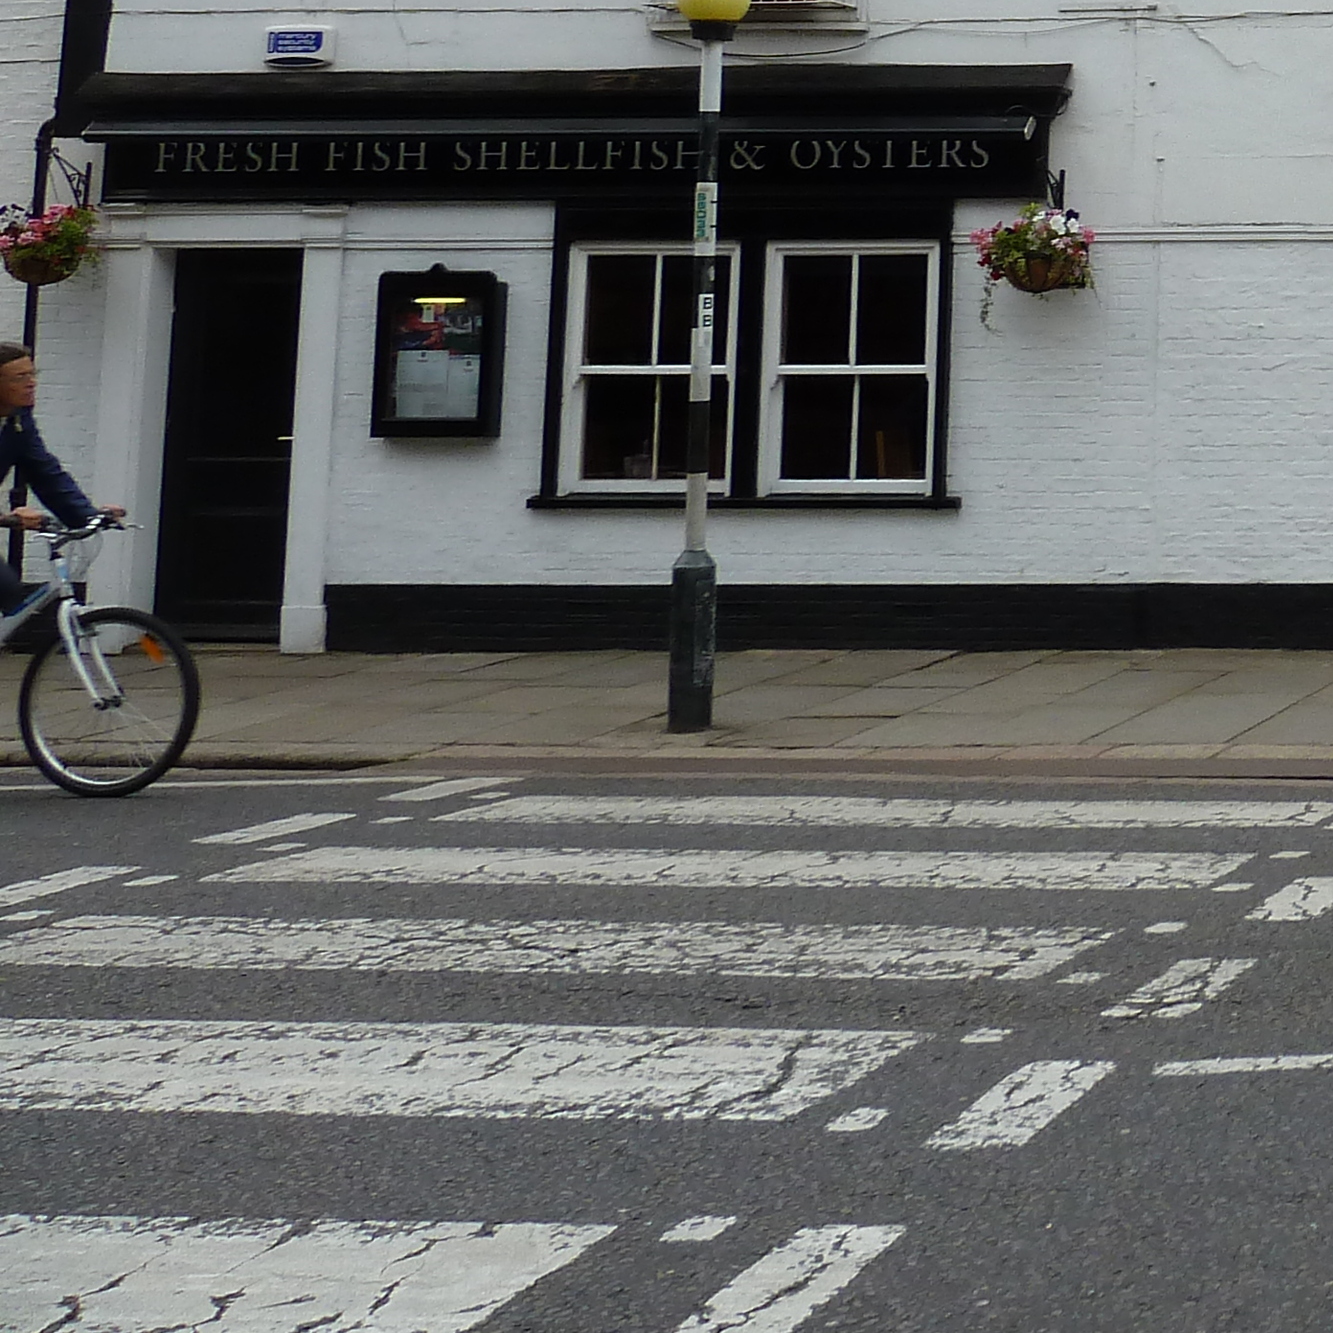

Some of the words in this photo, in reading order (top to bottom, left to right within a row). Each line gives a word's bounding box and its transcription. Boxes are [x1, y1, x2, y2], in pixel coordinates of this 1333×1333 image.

[154, 141, 300, 172] FRESH
[325, 140, 428, 171] FISH
[729, 139, 767, 170] &
[789, 139, 991, 169] OYSTERS
